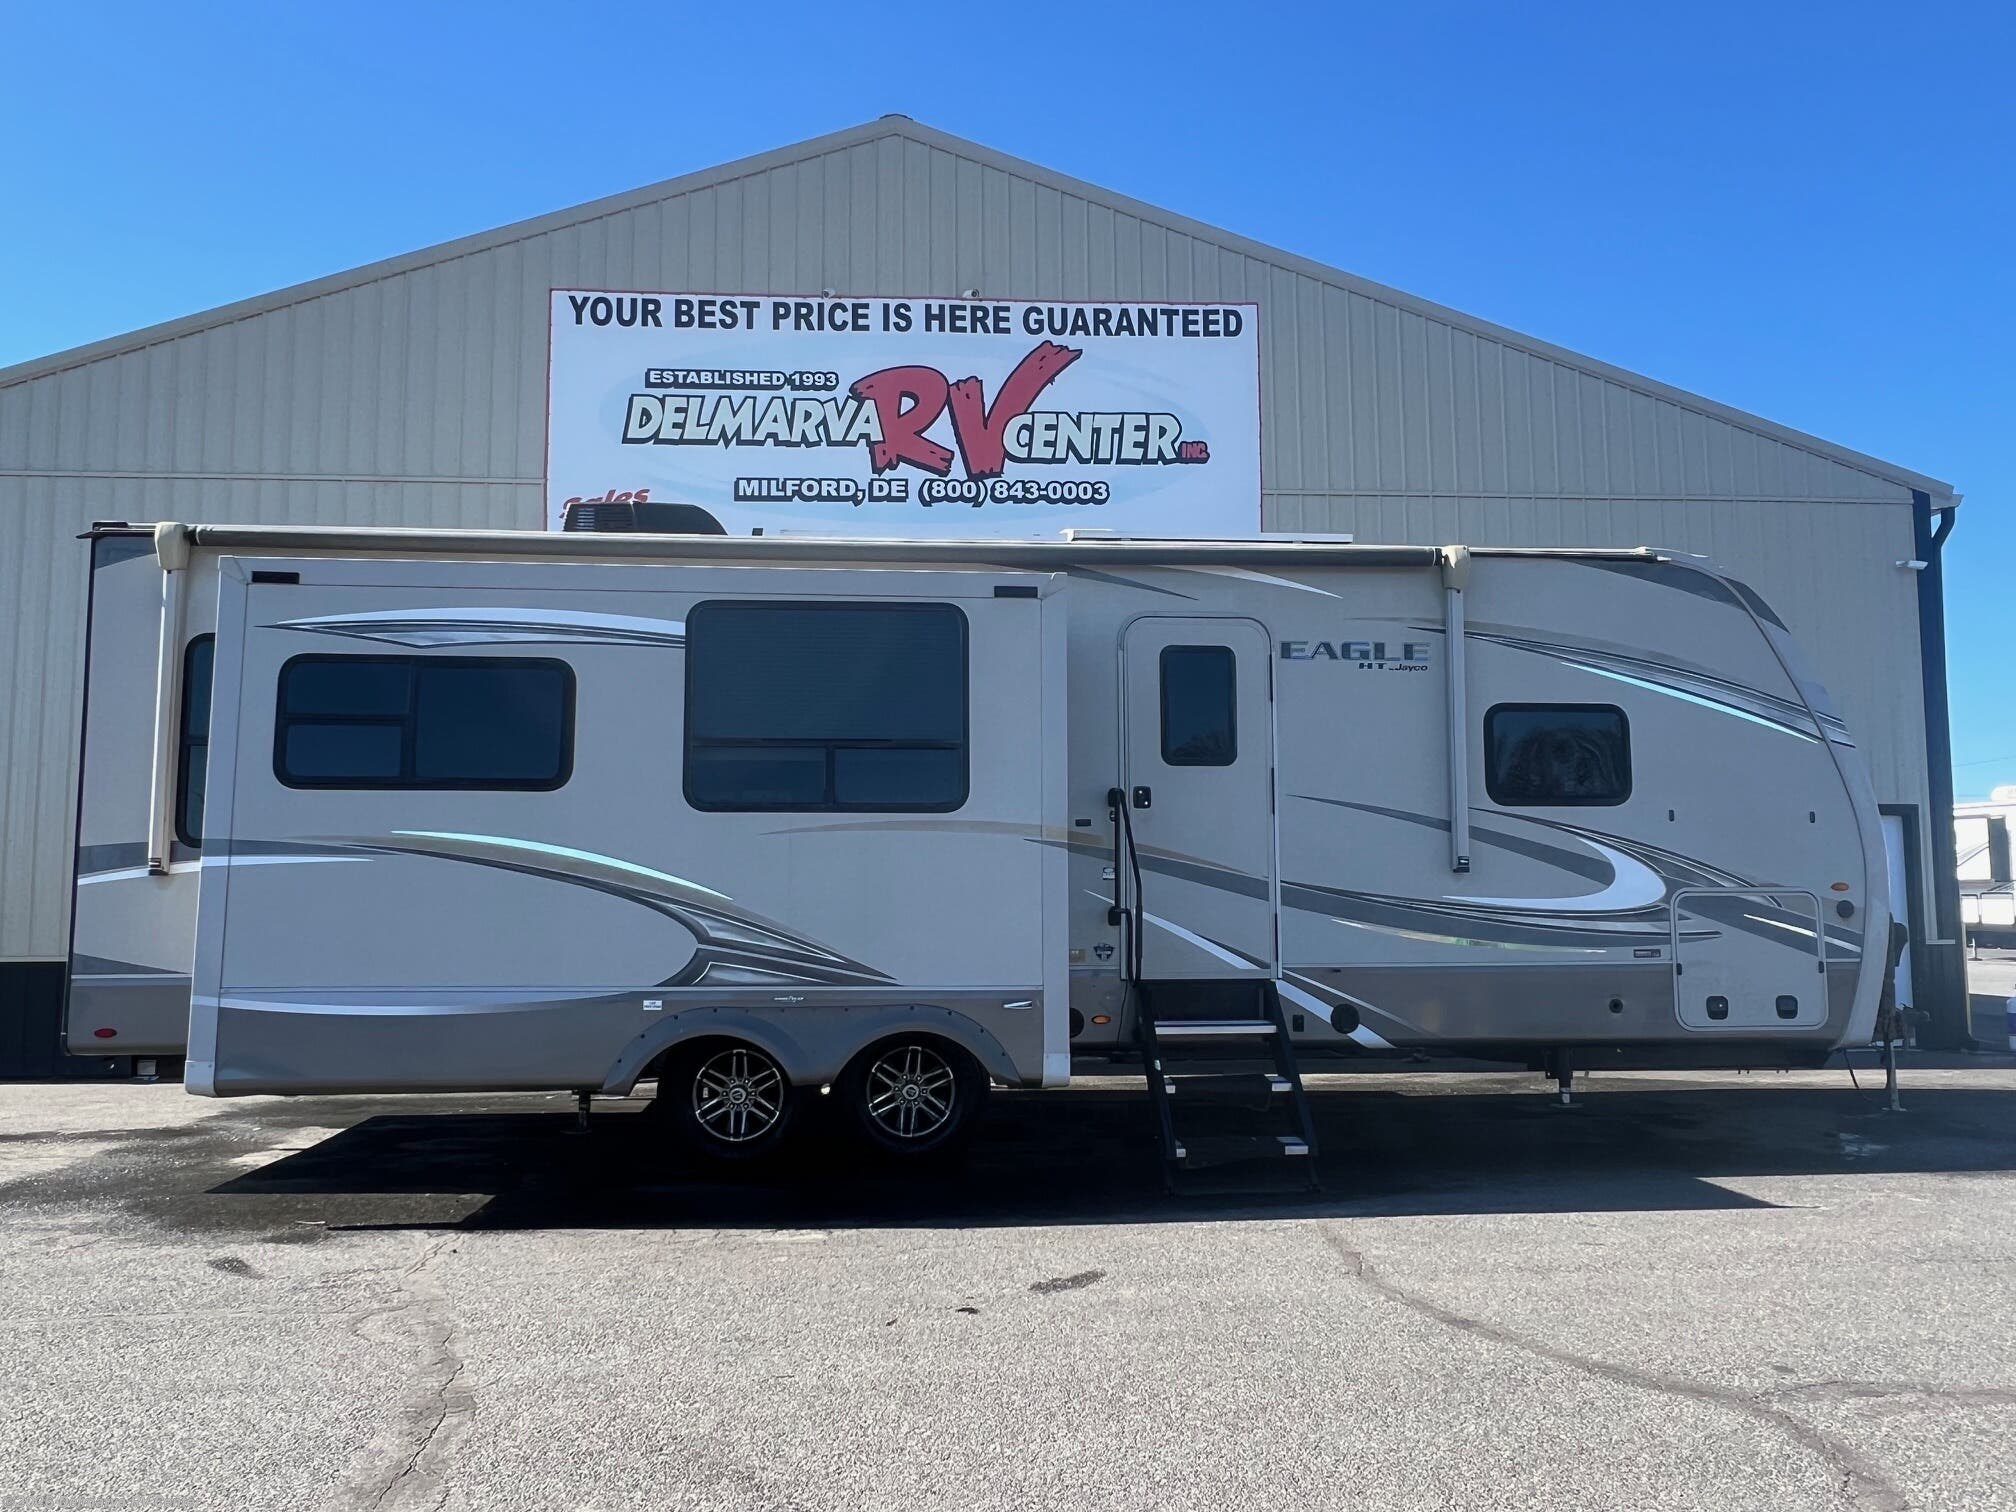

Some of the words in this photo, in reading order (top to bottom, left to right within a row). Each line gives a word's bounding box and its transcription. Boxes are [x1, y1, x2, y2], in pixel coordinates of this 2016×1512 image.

[568, 295, 663, 328] YOUR
[674, 299, 760, 330] BEST
[772, 301, 870, 332] PRICE
[882, 303, 913, 332] IS
[924, 303, 1011, 335] HERE
[1022, 306, 1242, 338] GUARANTEED
[646, 369, 785, 389] ESTABLISHED
[791, 372, 838, 390] 1993
[623, 394, 885, 447] DELMARVA
[849, 340, 1083, 480] RV
[1003, 411, 1182, 465] CENTER
[735, 478, 865, 505] MILFORD,
[868, 479, 907, 502] DE
[918, 479, 988, 506] (800)
[991, 480, 1110, 504] 843-0003
[1280, 641, 1430, 661] EAGLE
[1358, 662, 1387, 670] HT
